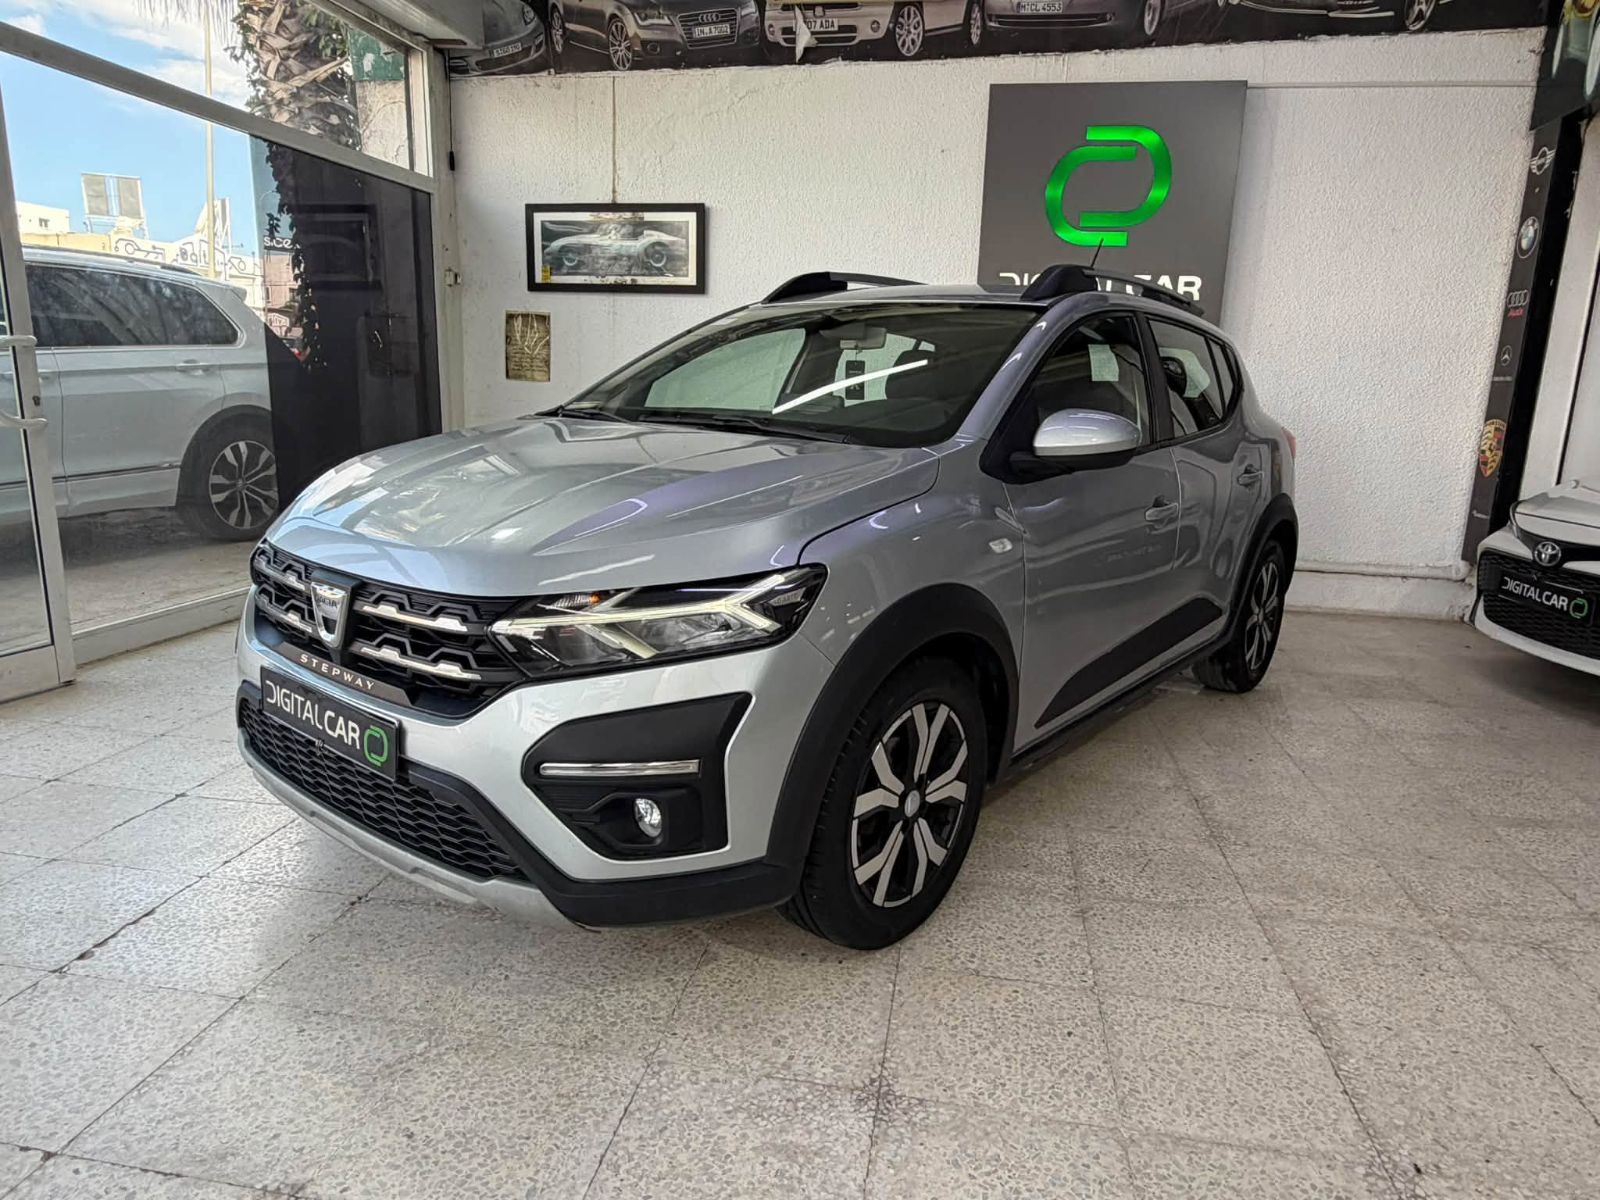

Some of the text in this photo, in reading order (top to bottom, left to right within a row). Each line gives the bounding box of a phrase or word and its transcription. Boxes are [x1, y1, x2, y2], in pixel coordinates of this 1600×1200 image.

[1501, 576, 1569, 612] DIGITALCAR
[299, 654, 375, 690] STEPWAY
[265, 679, 360, 750] DIGITALCAR
